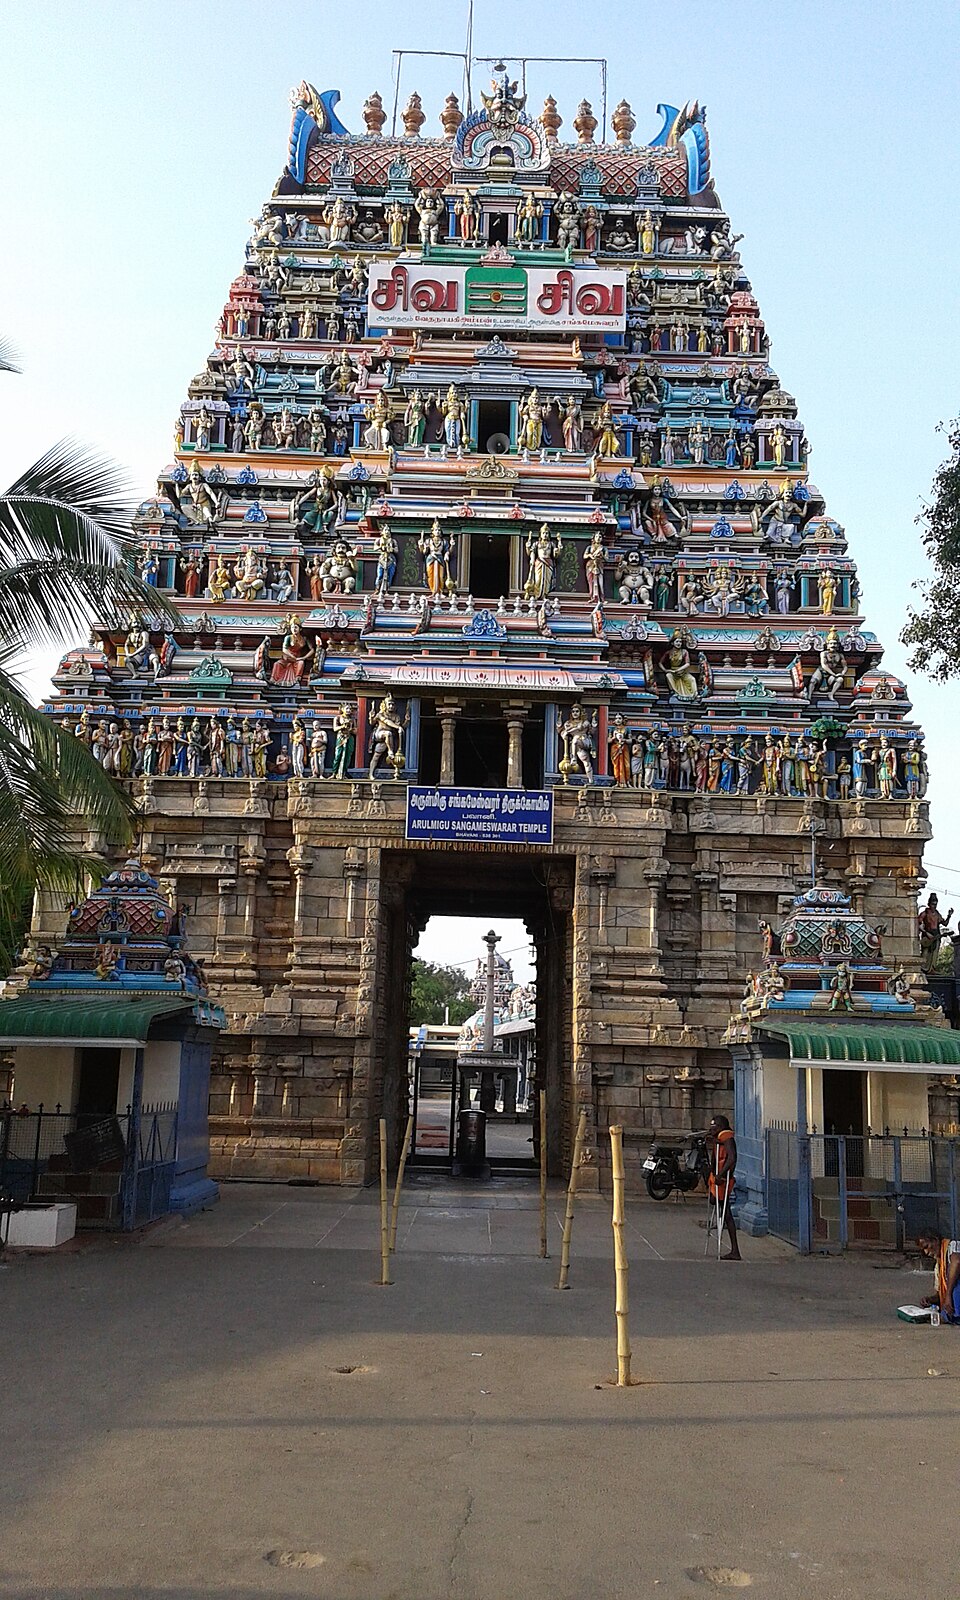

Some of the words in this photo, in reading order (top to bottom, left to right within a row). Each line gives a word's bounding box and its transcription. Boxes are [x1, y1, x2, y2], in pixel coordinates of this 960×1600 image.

[371, 265, 458, 312] சிவ
[536, 270, 624, 316] சிவ
[410, 790, 447, 811] அருள்மிகு
[411, 819, 450, 830] ARULMIGU
[451, 821, 517, 833] SANGAMESWARAR
[518, 823, 547, 834] TEMPLE
